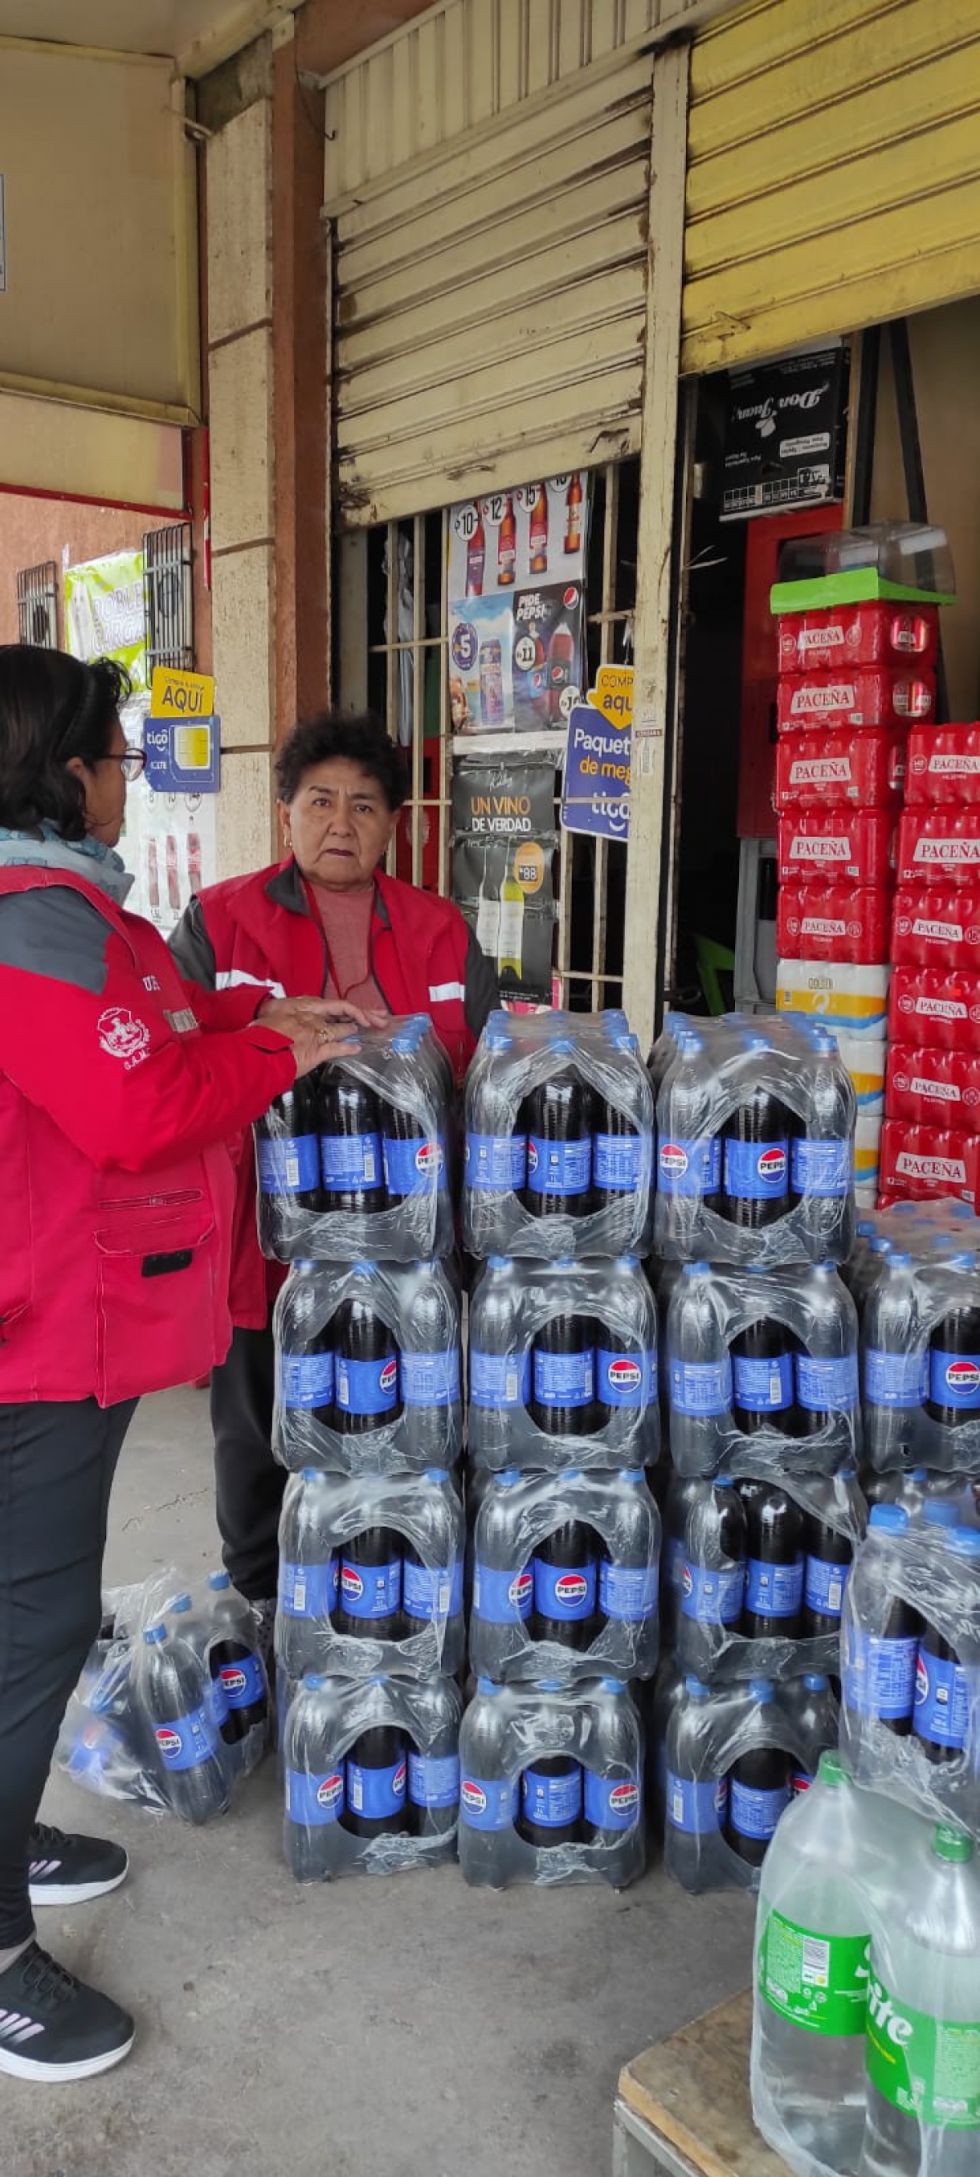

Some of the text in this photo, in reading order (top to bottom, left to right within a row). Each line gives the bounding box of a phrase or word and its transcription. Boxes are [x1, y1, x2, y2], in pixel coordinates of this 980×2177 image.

[796, 688, 850, 709] PACEÑA
[579, 755, 597, 775] de
[795, 761, 848, 780] PACEÑA
[471, 796, 531, 815] UN VINO
[472, 817, 532, 832] DE VERDAD
[796, 840, 847, 857] PACEÑA
[609, 1371, 640, 1380] PEPSI
[948, 1372, 980, 1382] PEPSI
[557, 1585, 586, 1594] PEPSI
